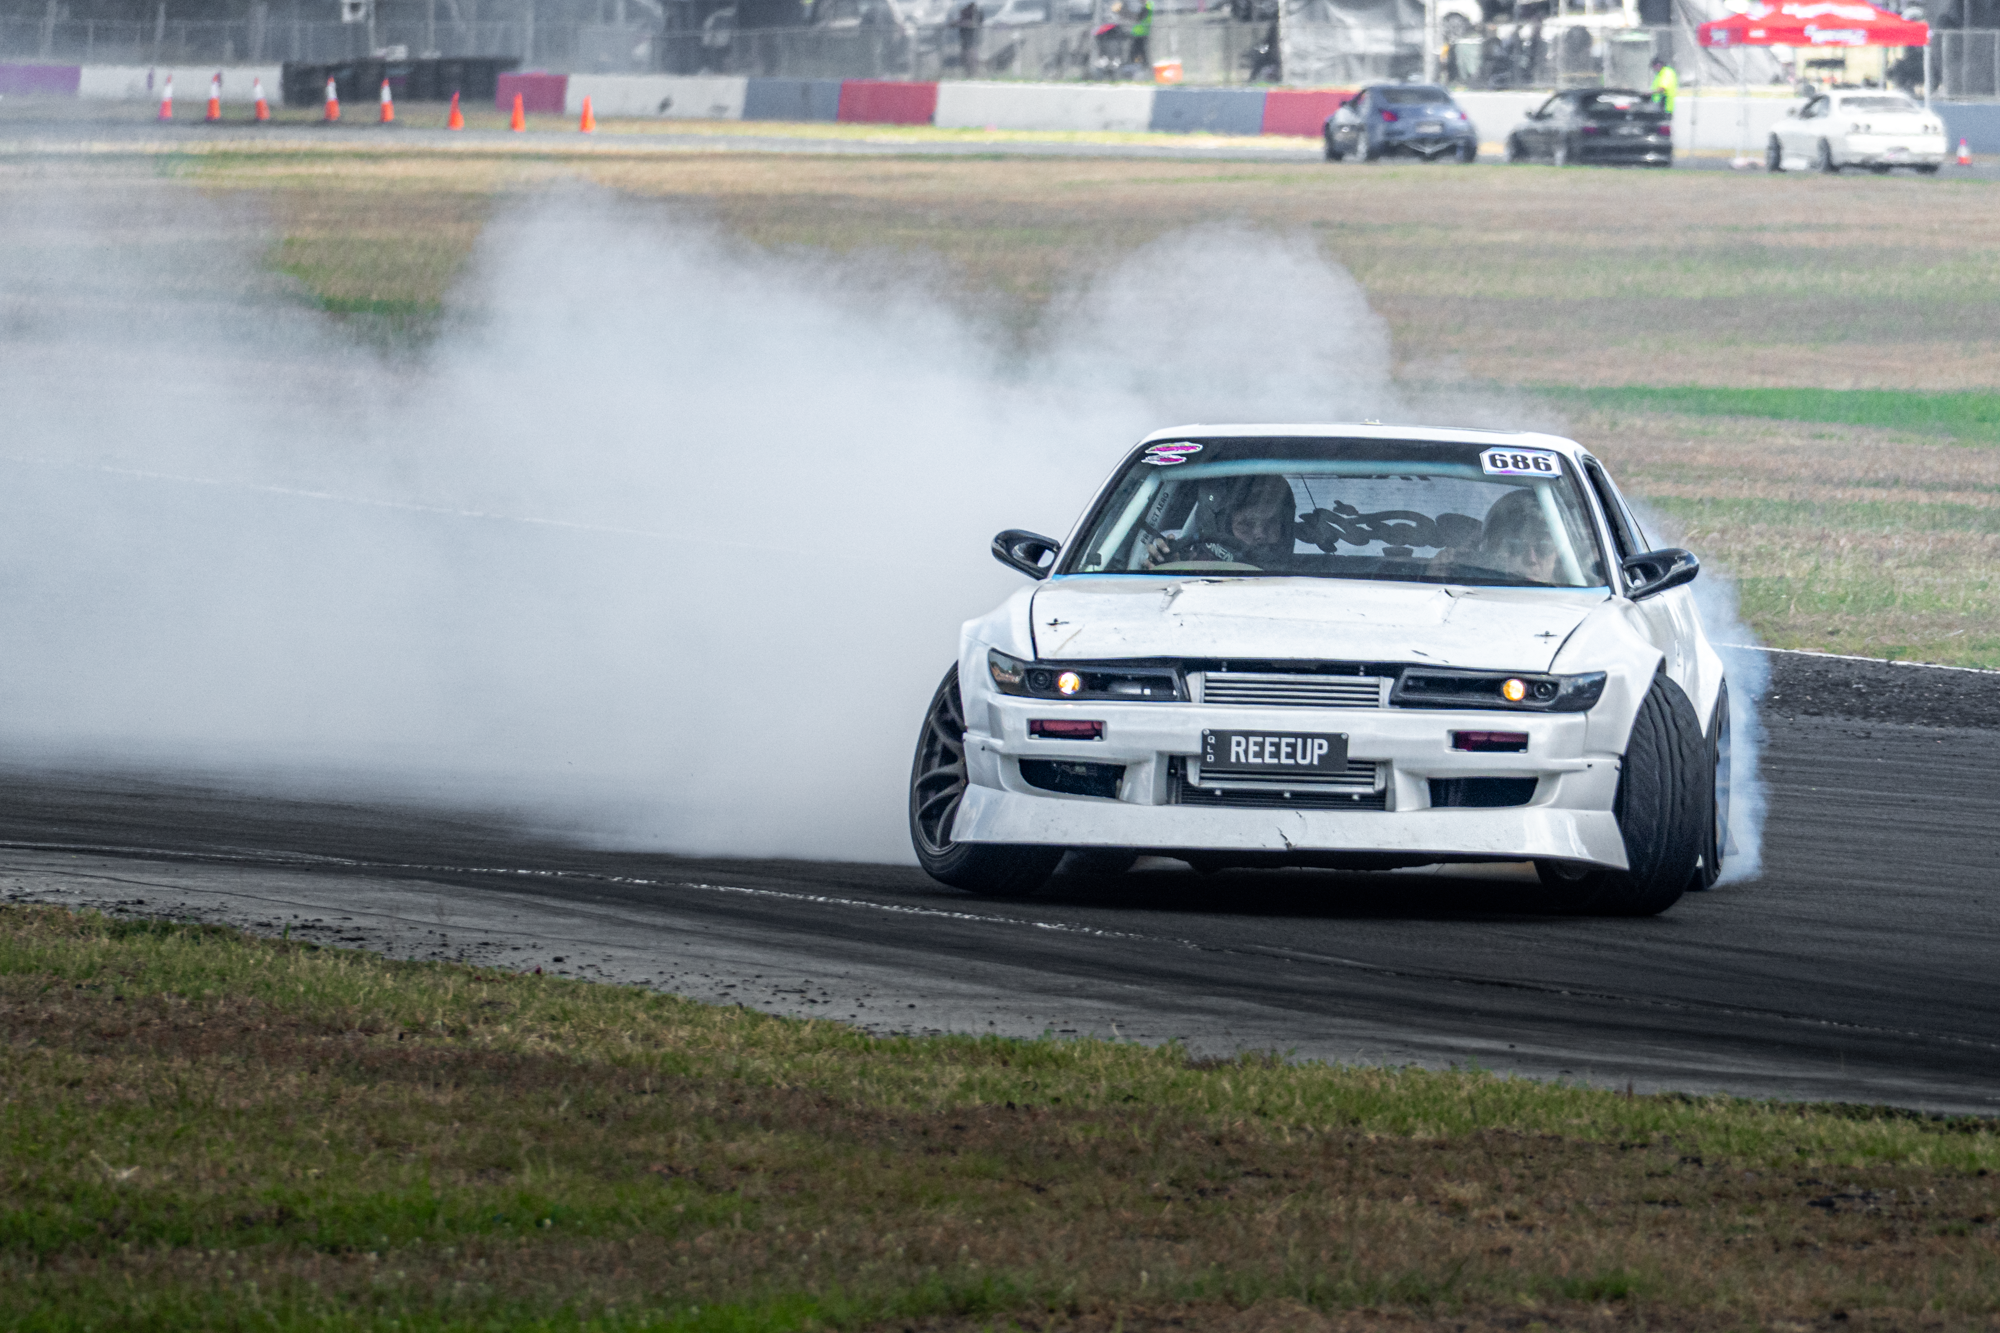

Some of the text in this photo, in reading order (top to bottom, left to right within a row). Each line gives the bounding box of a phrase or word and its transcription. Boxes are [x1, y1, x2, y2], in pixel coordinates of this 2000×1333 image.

[1488, 453, 1552, 472] 686
[1206, 735, 1216, 763] QLD
[1230, 735, 1329, 766] REEEUP
